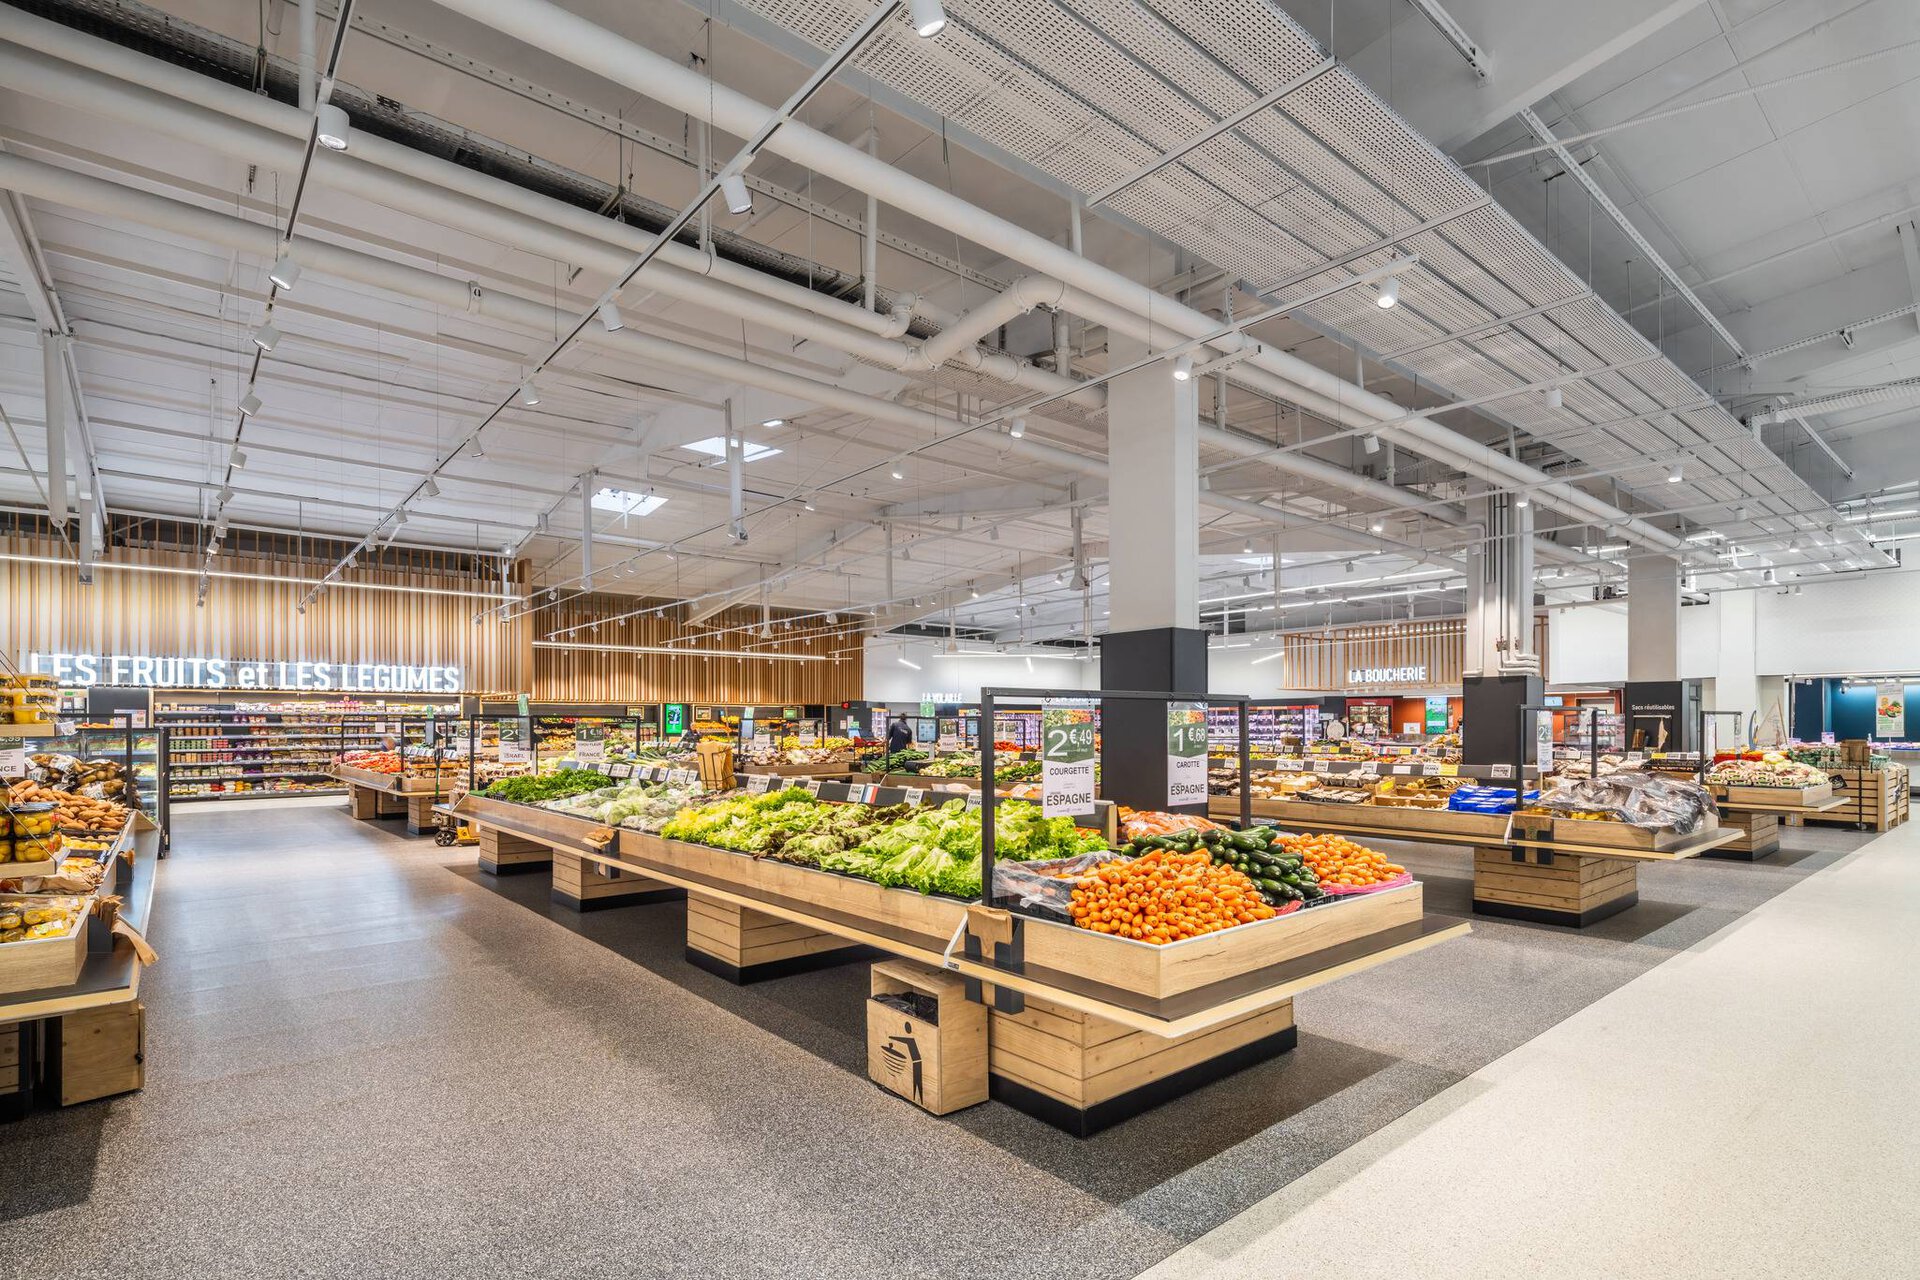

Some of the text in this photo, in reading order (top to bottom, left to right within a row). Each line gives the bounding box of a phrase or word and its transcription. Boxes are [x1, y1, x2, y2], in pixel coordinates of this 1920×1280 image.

[112, 656, 226, 688] FRUITS
[238, 662, 268, 689] et
[280, 662, 331, 690] LES
[343, 664, 459, 692] LEGUMES
[1349, 667, 1427, 683] LA BOUCHERIE
[1645, 703, 1675, 711] réutilisables
[1176, 760, 1200, 769] CAROTTE
[1049, 766, 1090, 776] COURGETTE
[1170, 784, 1205, 796] ESPAGNE
[1046, 792, 1092, 807] ESPAGNE
